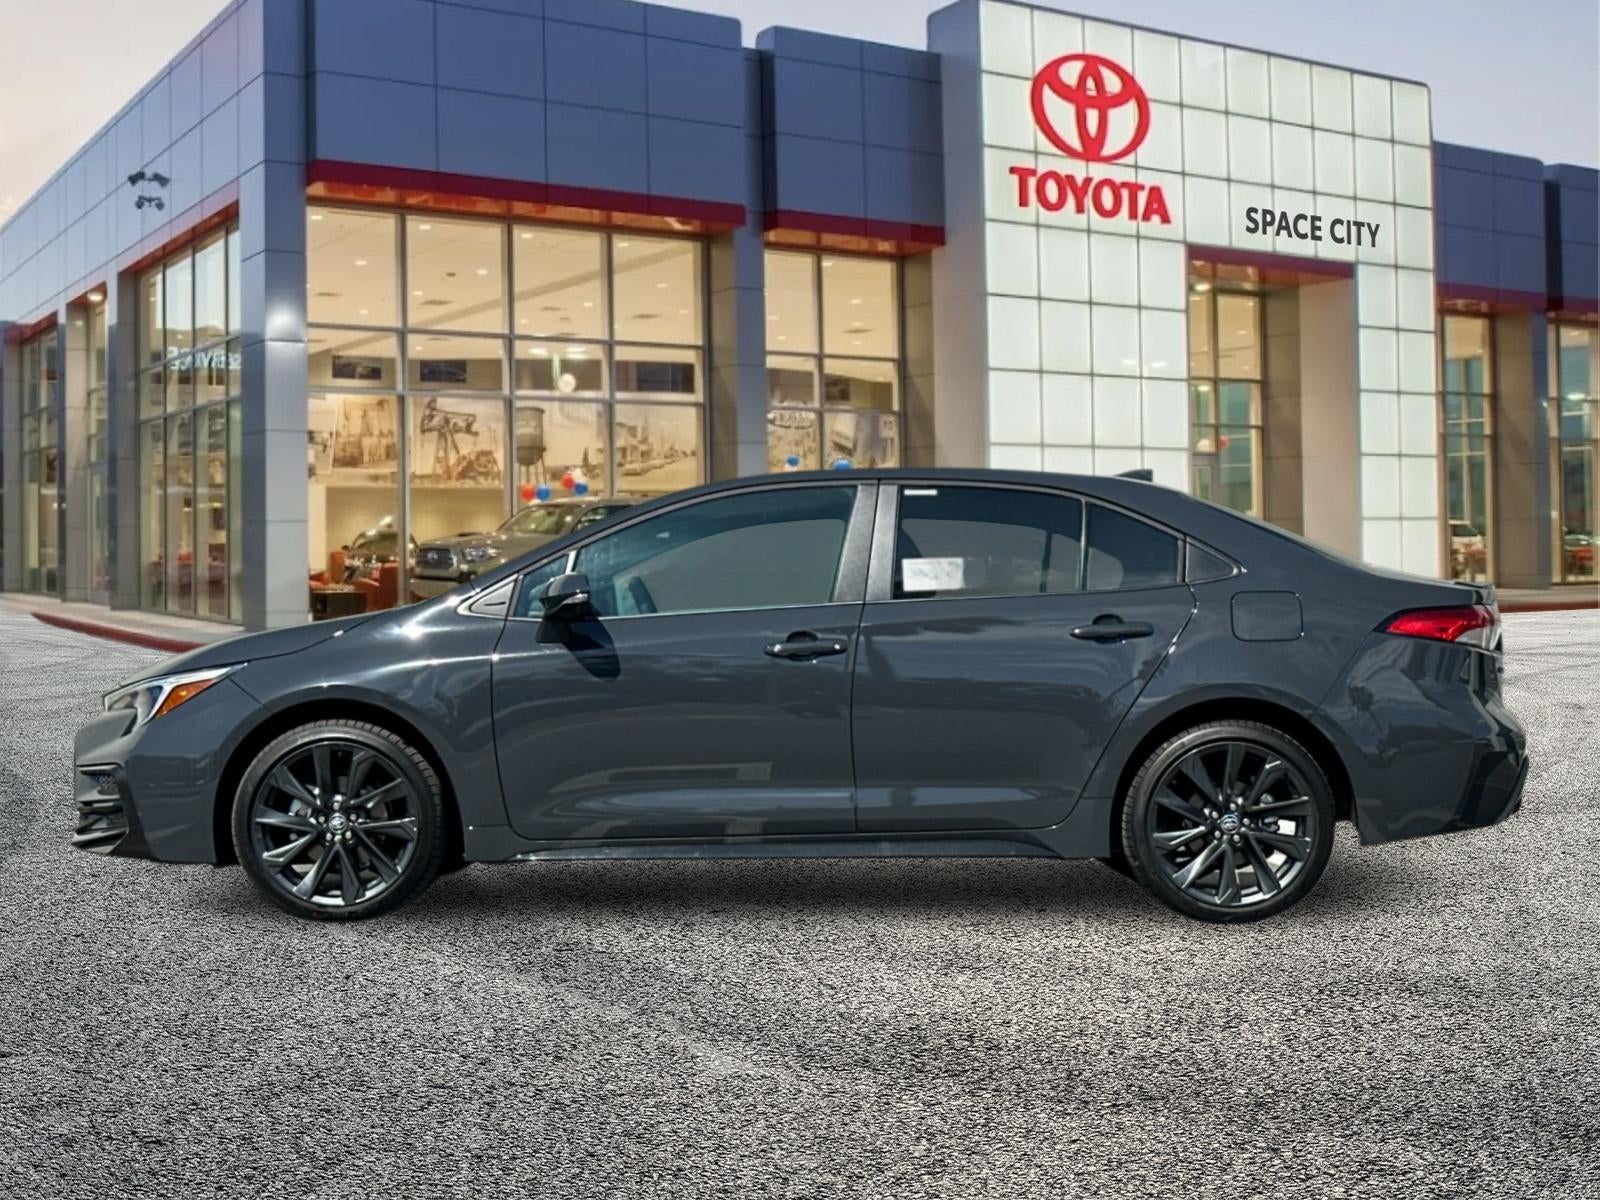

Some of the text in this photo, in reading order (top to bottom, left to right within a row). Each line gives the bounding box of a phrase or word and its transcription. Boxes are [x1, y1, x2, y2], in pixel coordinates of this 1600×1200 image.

[1009, 166, 1171, 224] TOYOTA
[1245, 207, 1381, 248] SPACE CITY
